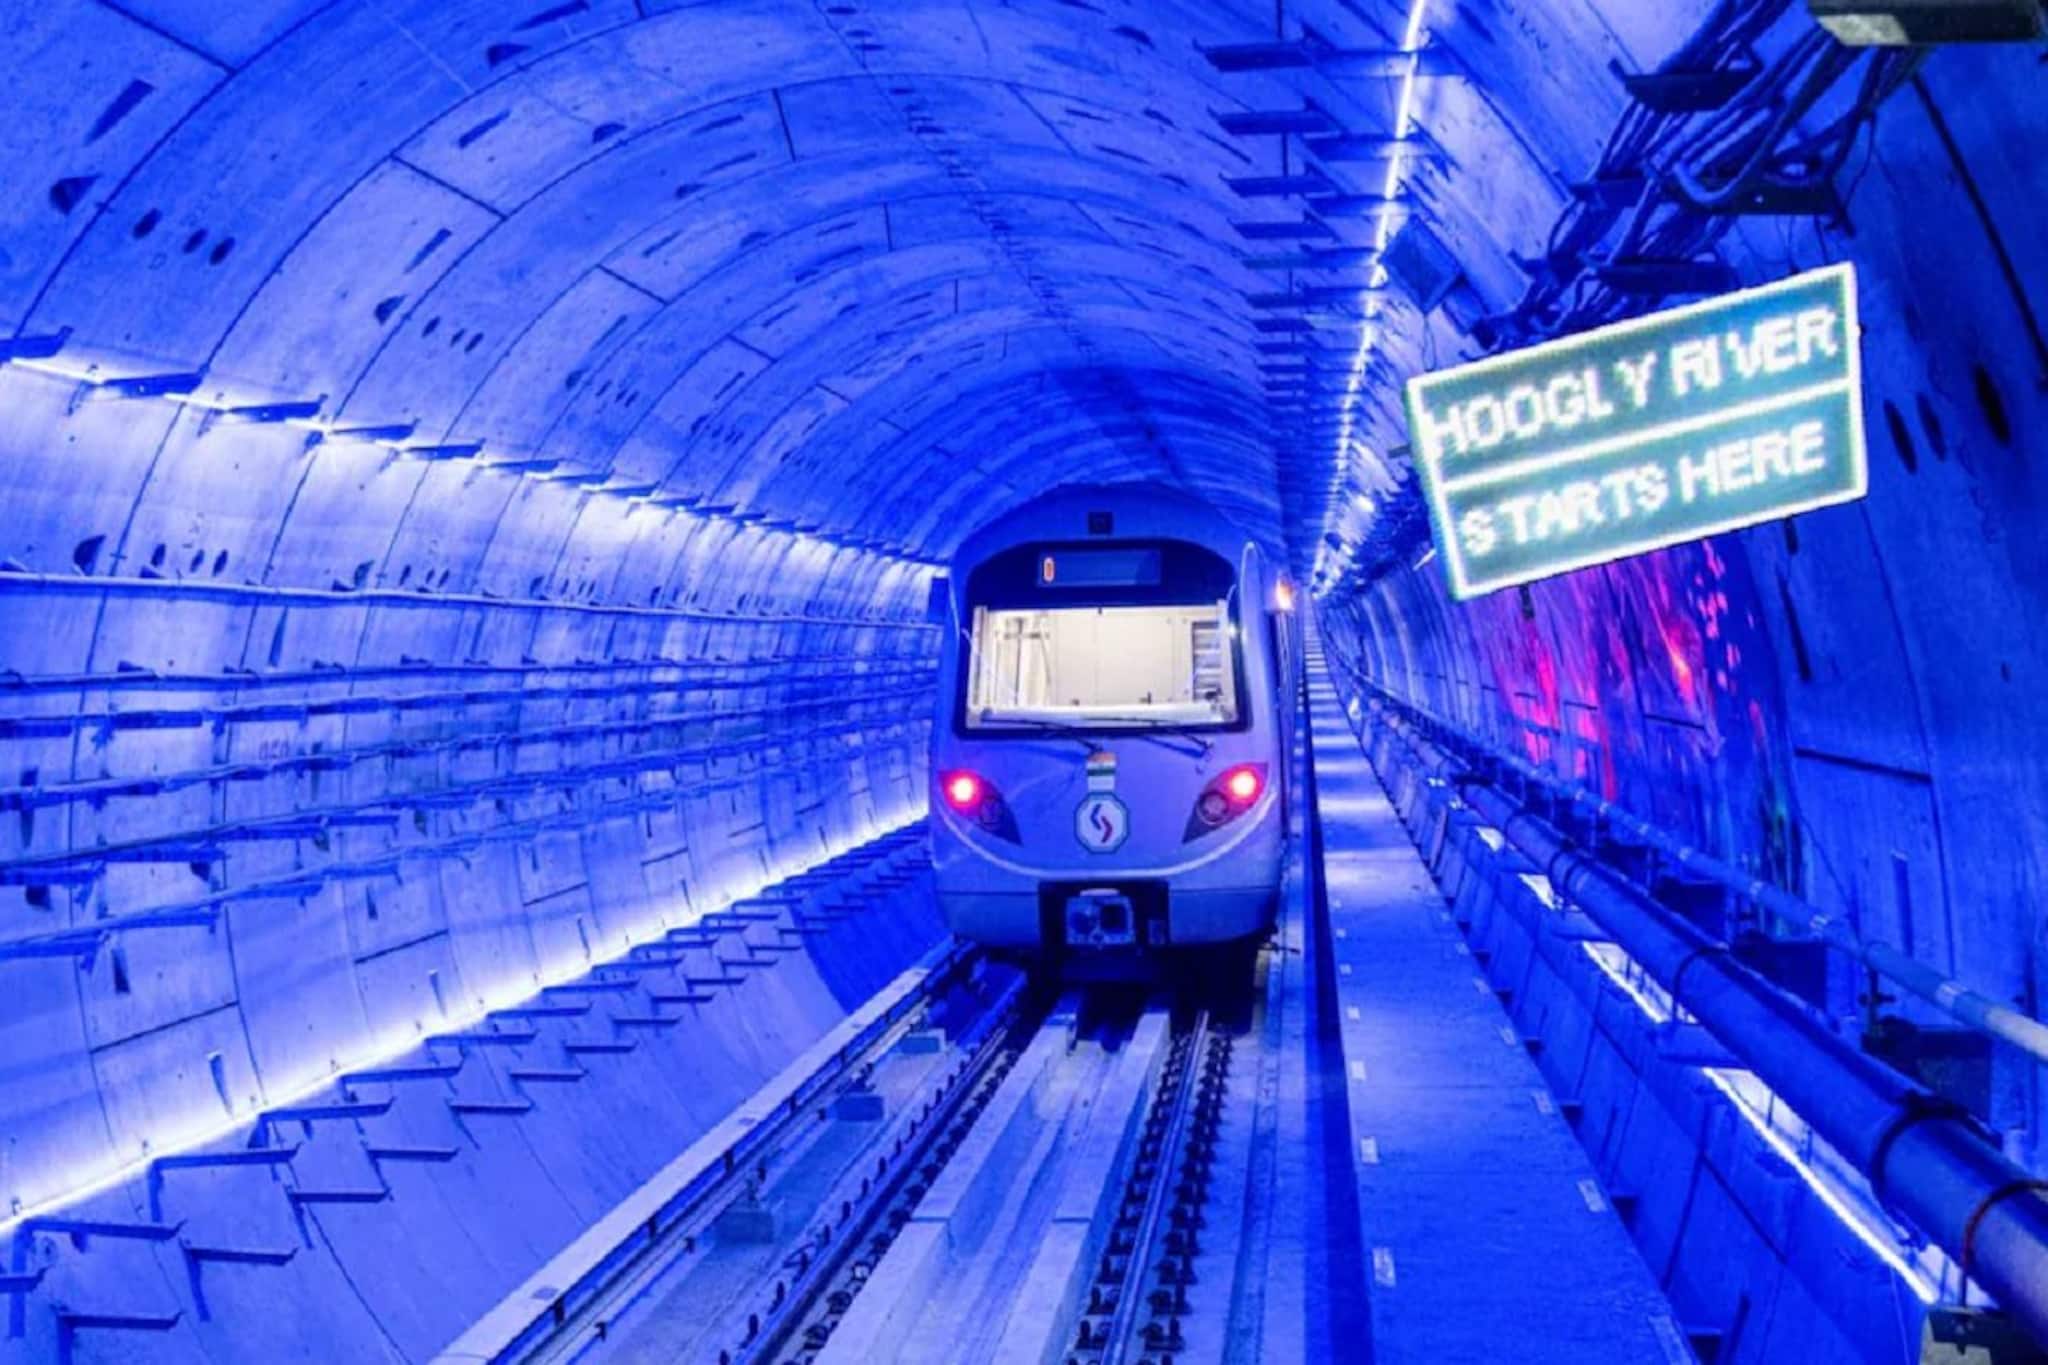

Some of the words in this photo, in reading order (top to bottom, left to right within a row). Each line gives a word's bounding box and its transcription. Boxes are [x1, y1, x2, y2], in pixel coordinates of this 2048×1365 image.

[1424, 352, 1656, 460] HOOGLY
[1671, 305, 1838, 395] RIVER
[1461, 463, 1669, 556] STARTS
[1679, 420, 1826, 502] HERE
